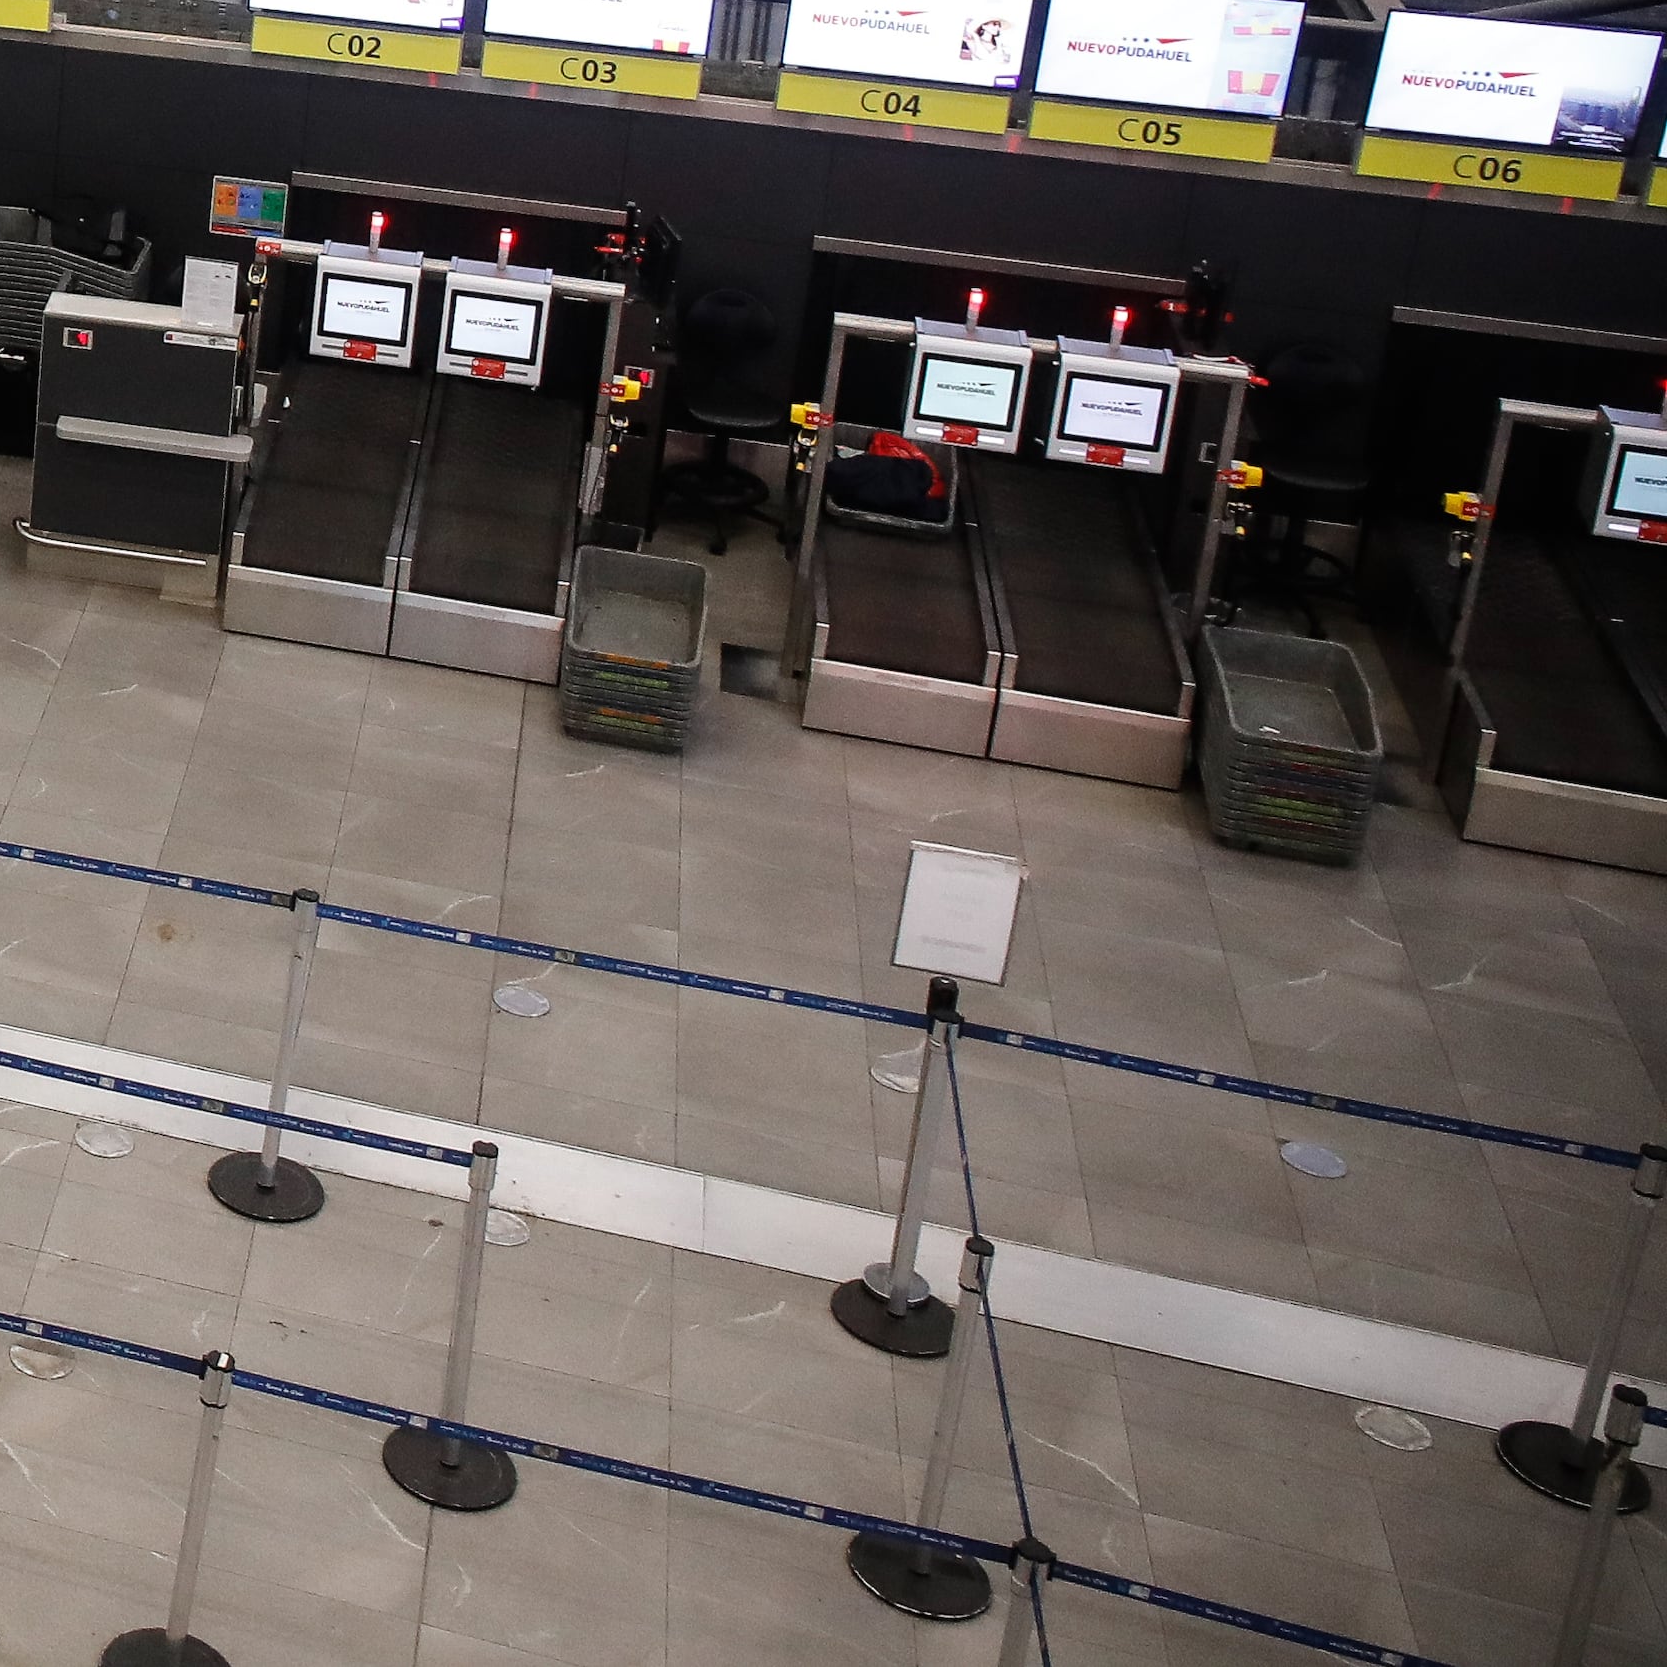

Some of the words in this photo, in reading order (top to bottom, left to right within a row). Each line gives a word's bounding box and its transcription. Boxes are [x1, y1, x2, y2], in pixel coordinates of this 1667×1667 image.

[812, 13, 931, 36] NUEVOPUDAHUEL
[326, 32, 382, 60] C02
[1066, 40, 1193, 64] NUEVOPUDAHUEL
[559, 56, 618, 84] C03
[1401, 73, 1537, 98] NUEVOPUDAHUEL
[860, 88, 922, 118] C04
[1117, 117, 1182, 146] C05
[1453, 153, 1523, 184] C06
